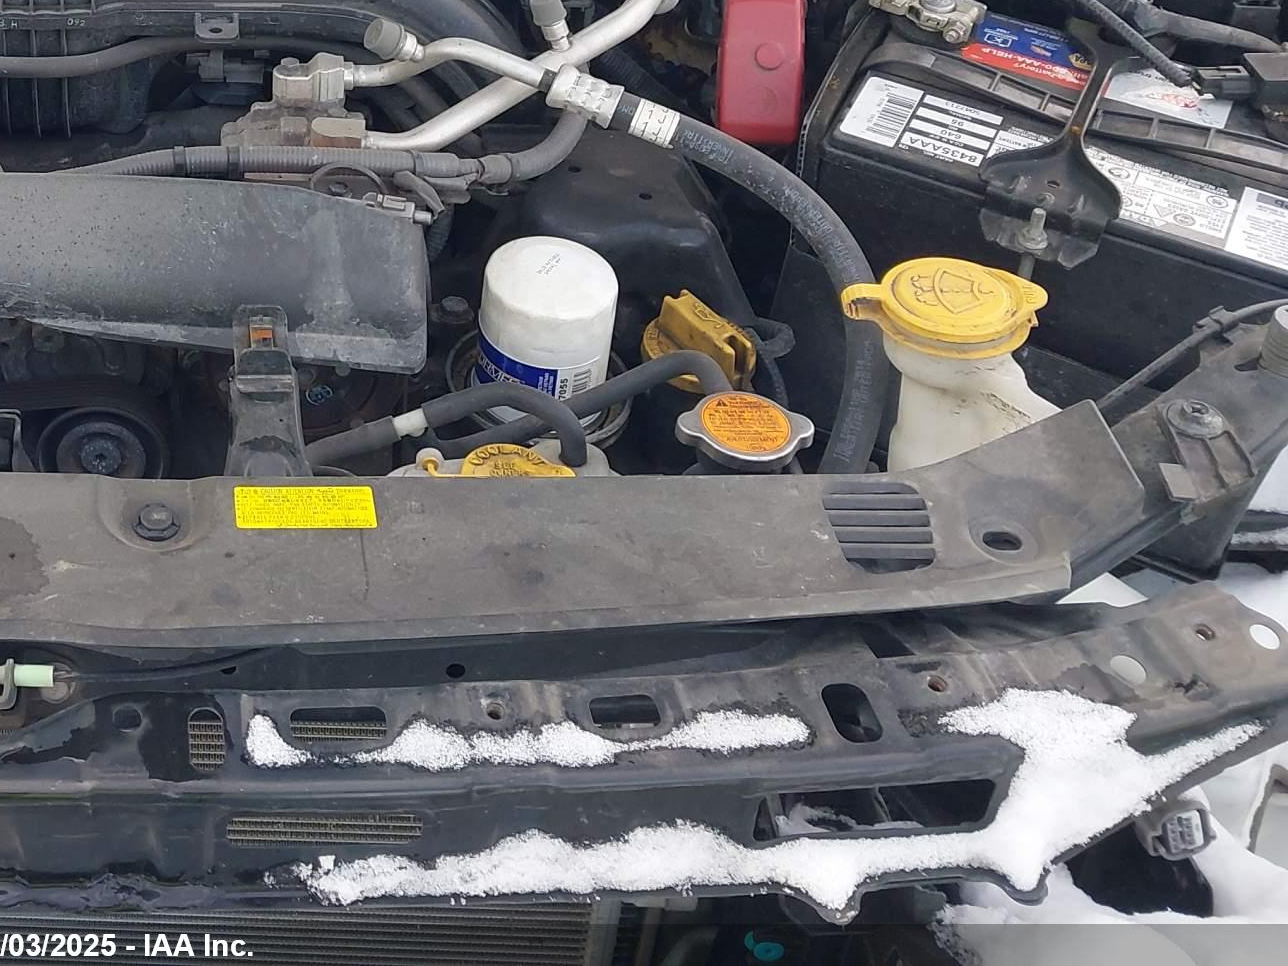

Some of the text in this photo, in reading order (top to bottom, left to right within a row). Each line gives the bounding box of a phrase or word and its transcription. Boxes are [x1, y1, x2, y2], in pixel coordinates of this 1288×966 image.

[940, 128, 961, 140] 640
[910, 136, 977, 163] 8435AAA
[469, 445, 545, 466] COOLANT
